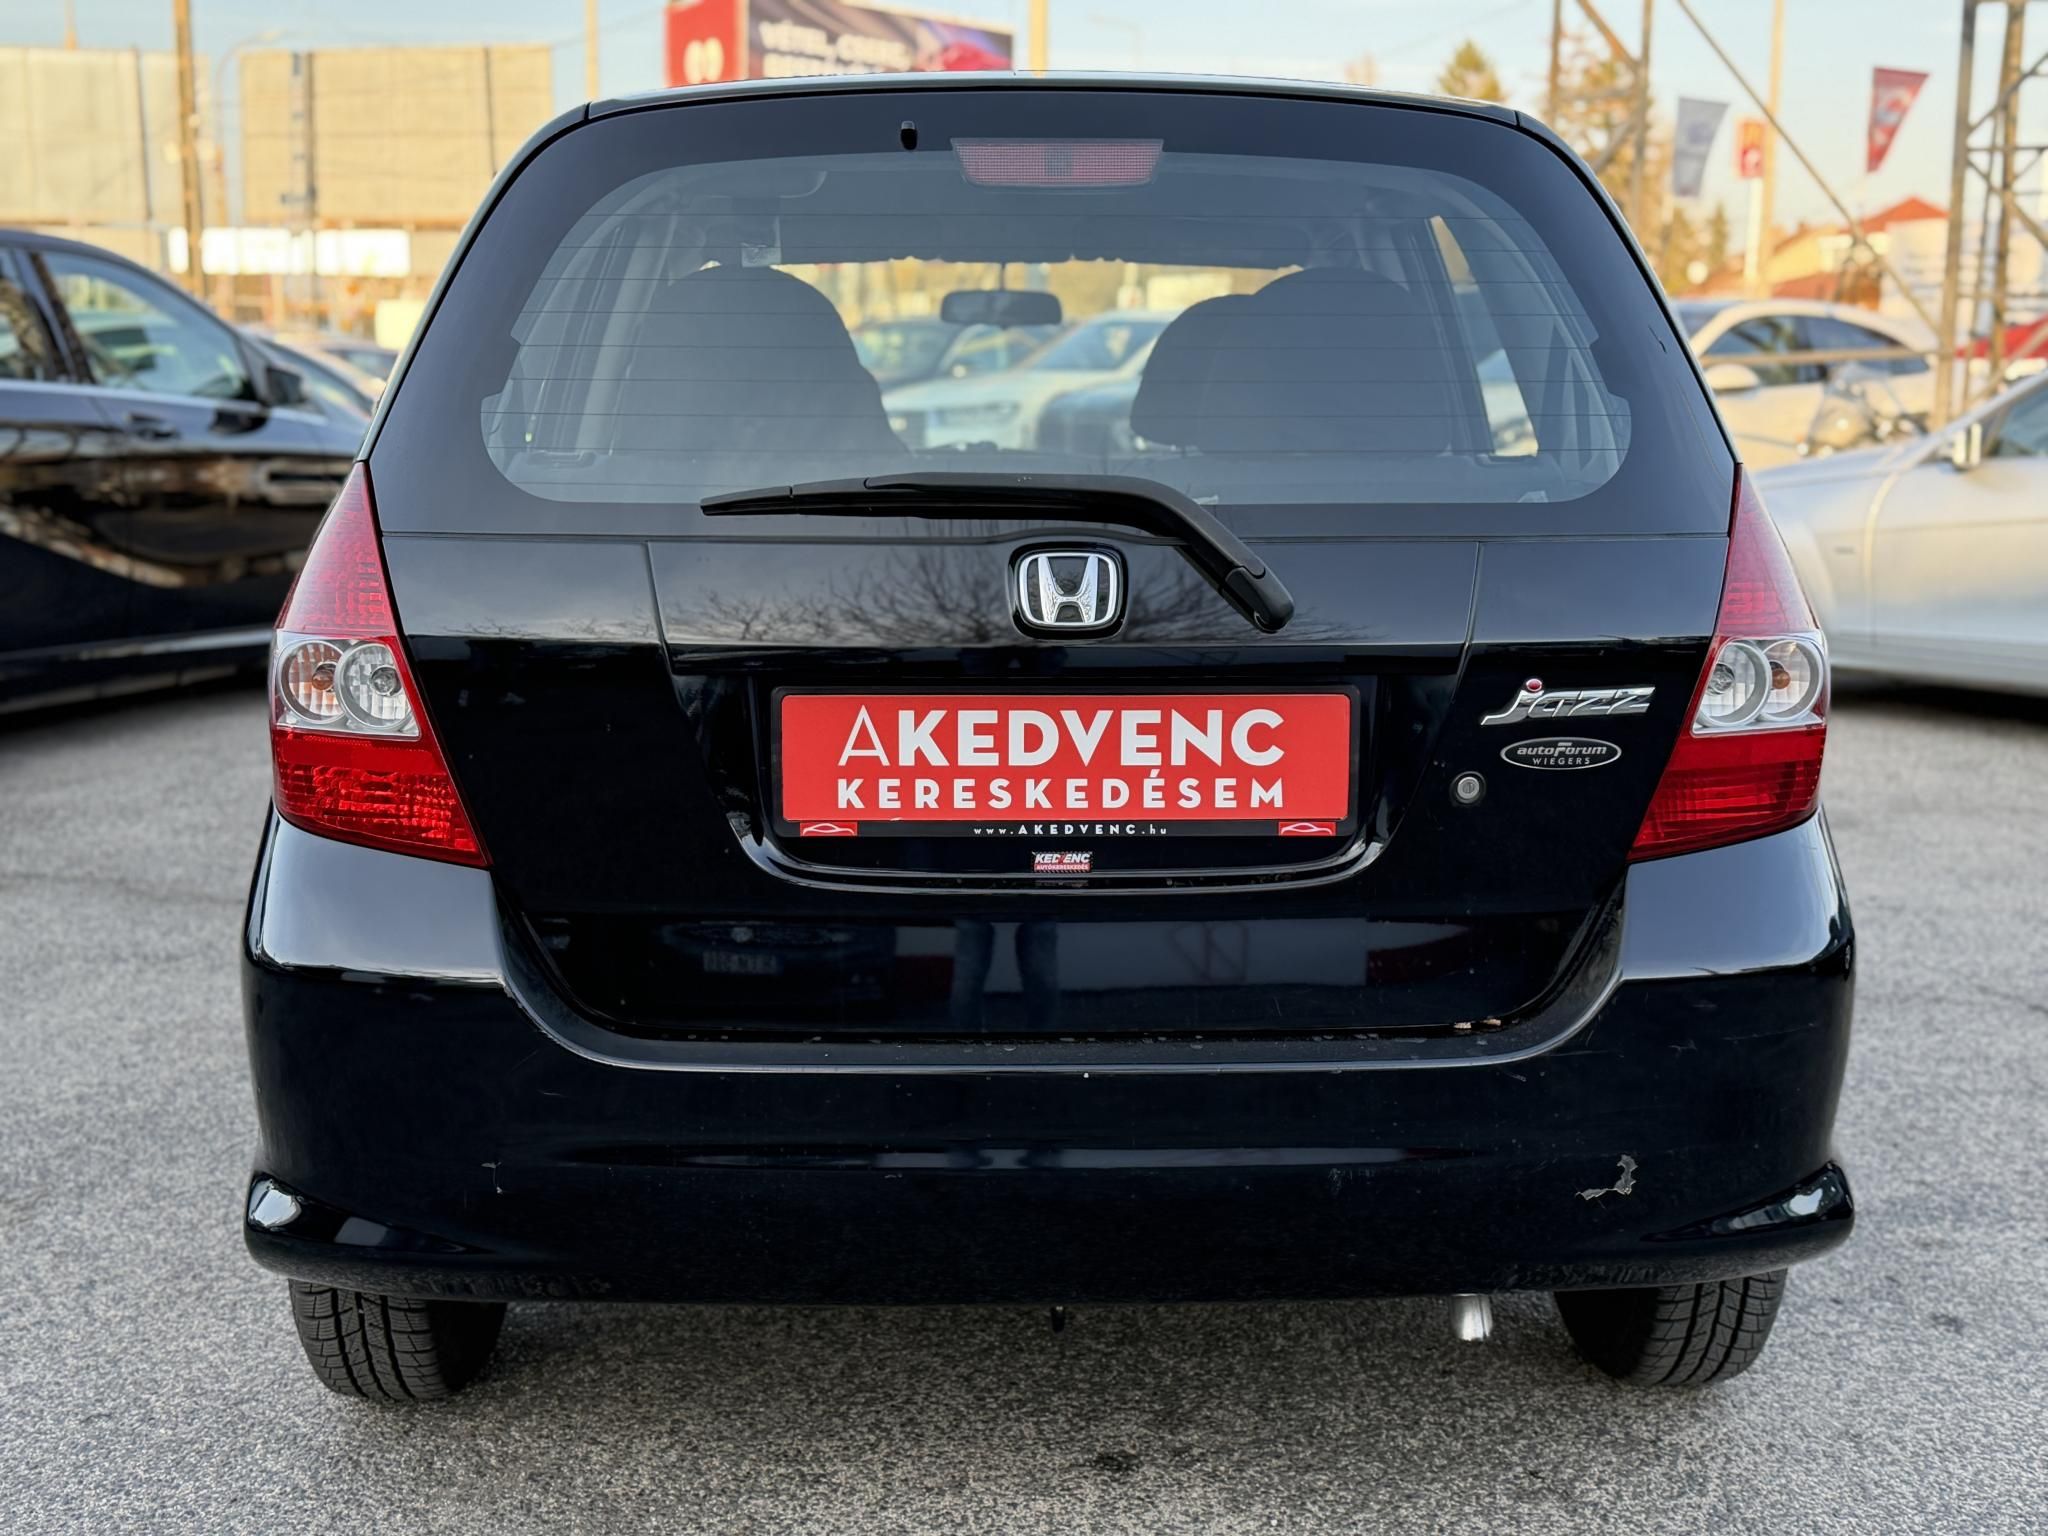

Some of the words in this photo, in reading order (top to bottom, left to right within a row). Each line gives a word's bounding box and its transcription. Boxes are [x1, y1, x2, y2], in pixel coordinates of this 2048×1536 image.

[1532, 757, 1590, 765] WIEGERS
[837, 769, 1284, 810] KERESKEDÉSEM
[973, 824, 1167, 835] www.AKEDVENC.hu
